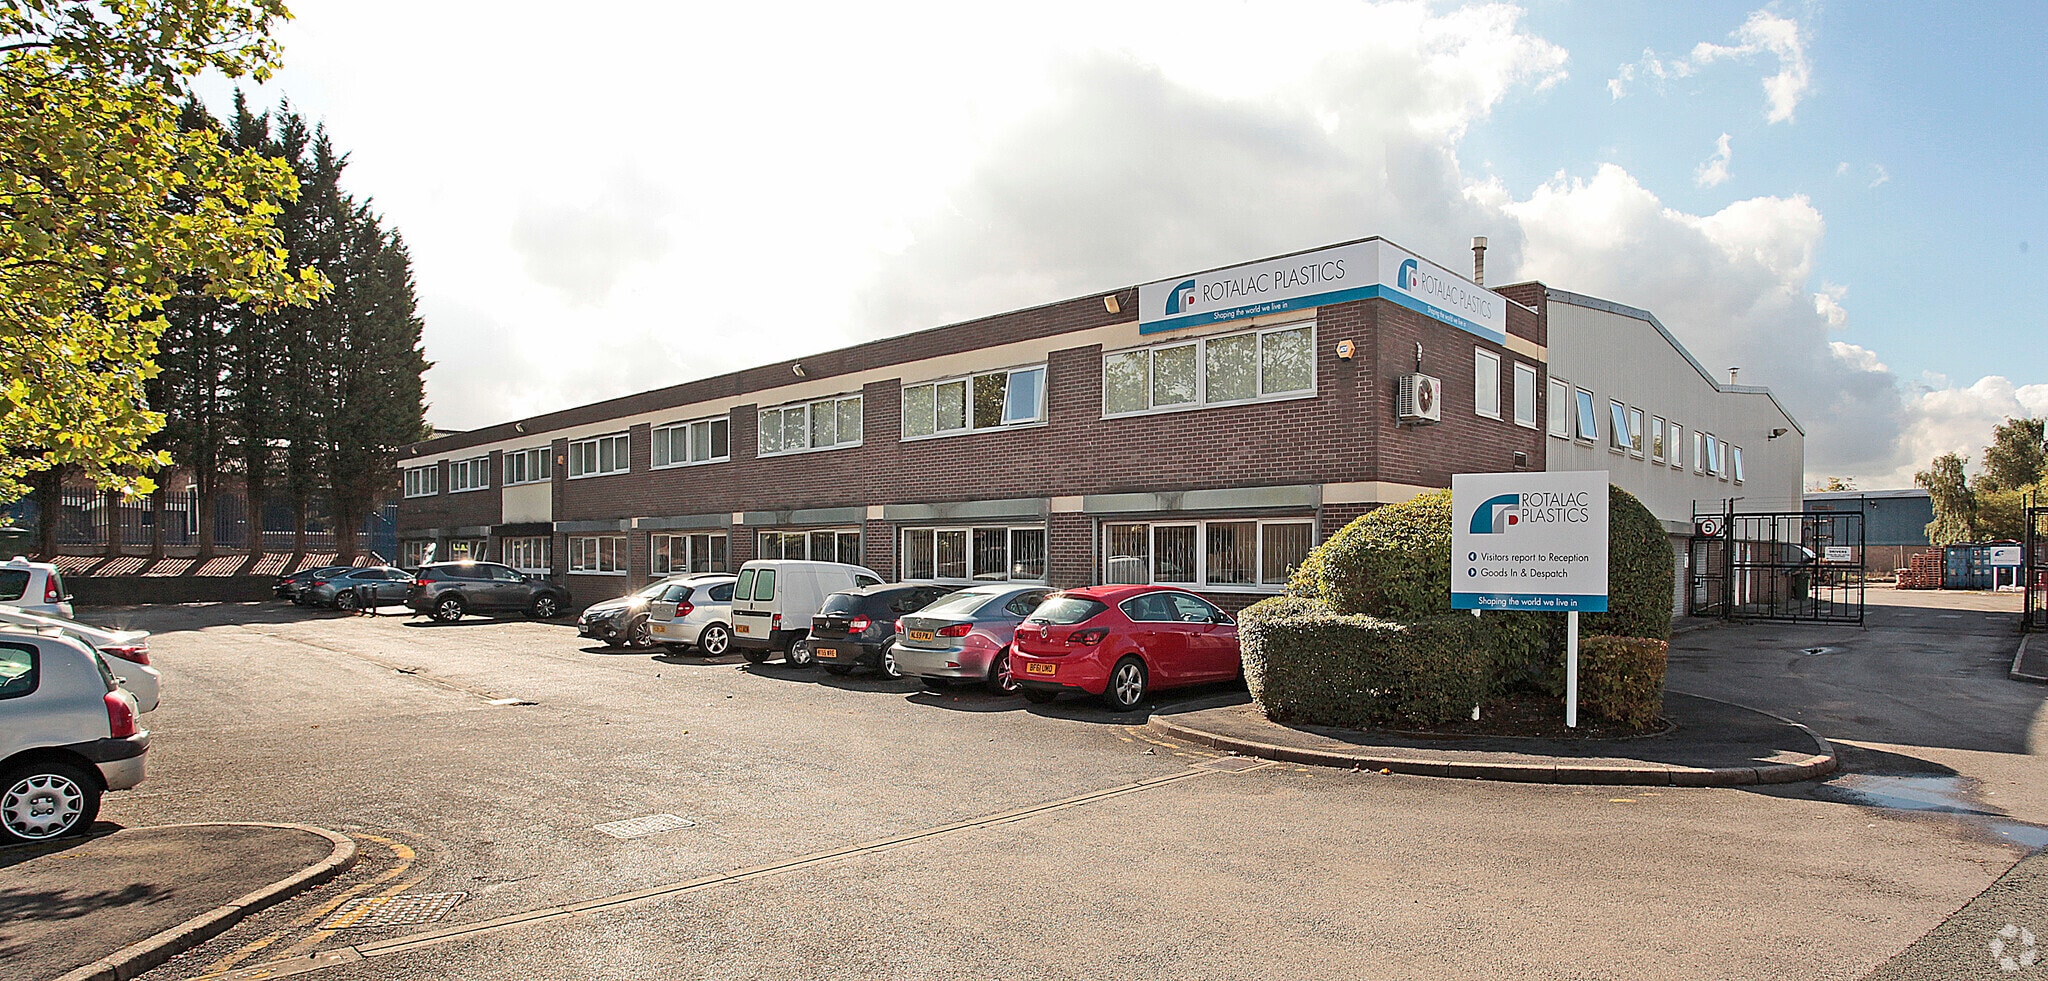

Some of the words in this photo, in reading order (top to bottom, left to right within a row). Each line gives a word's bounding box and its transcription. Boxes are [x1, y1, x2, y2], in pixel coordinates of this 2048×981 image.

[1203, 274, 1269, 302] ROTALAC
[1275, 259, 1345, 290] PLASTICS
[1421, 272, 1457, 305] ROTALAC
[1460, 290, 1492, 319] PLASTICS
[1213, 311, 1235, 320] Shaping
[1236, 308, 1244, 316] the
[1245, 304, 1260, 314] world
[1271, 302, 1281, 311] live
[1522, 492, 1588, 507] ROTALAC
[1522, 508, 1589, 523] PLASTICS
[1705, 523, 1712, 533] 5
[1481, 552, 1509, 562] Visitors
[1511, 553, 1536, 564] report
[1538, 554, 1546, 562] to
[1549, 552, 1589, 565] Reception
[1480, 567, 1508, 578] Goods
[1510, 568, 1518, 577] In
[1520, 568, 1527, 577] &
[1530, 568, 1568, 580] Despatch
[1478, 596, 1507, 607] Shaping
[1508, 597, 1519, 606] the
[1521, 597, 1541, 606] world
[1556, 598, 1568, 607] live
[1570, 599, 1578, 607] in
